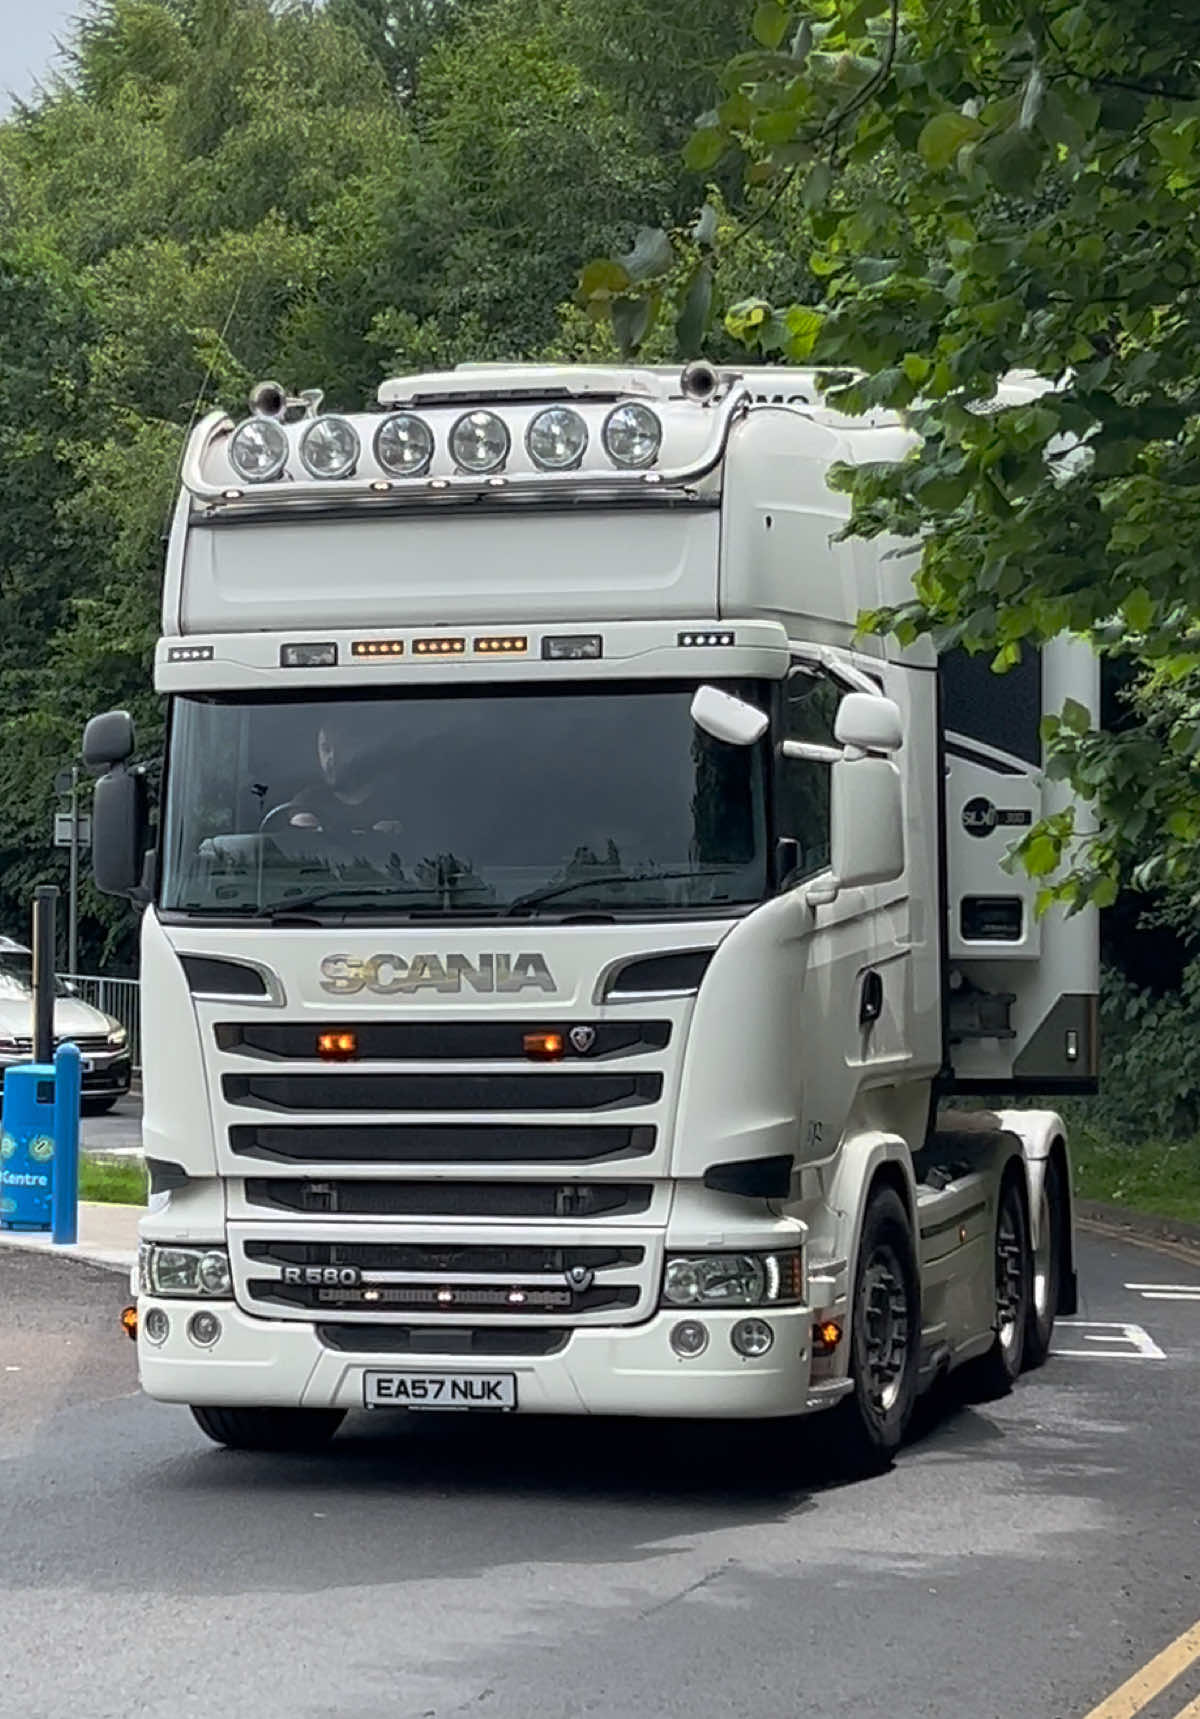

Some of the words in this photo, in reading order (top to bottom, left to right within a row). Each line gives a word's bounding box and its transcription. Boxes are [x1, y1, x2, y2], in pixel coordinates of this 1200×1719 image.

[319, 953, 557, 994] SCANIA
[376, 1378, 446, 1399] EA57
[451, 1380, 503, 1401] NUK
